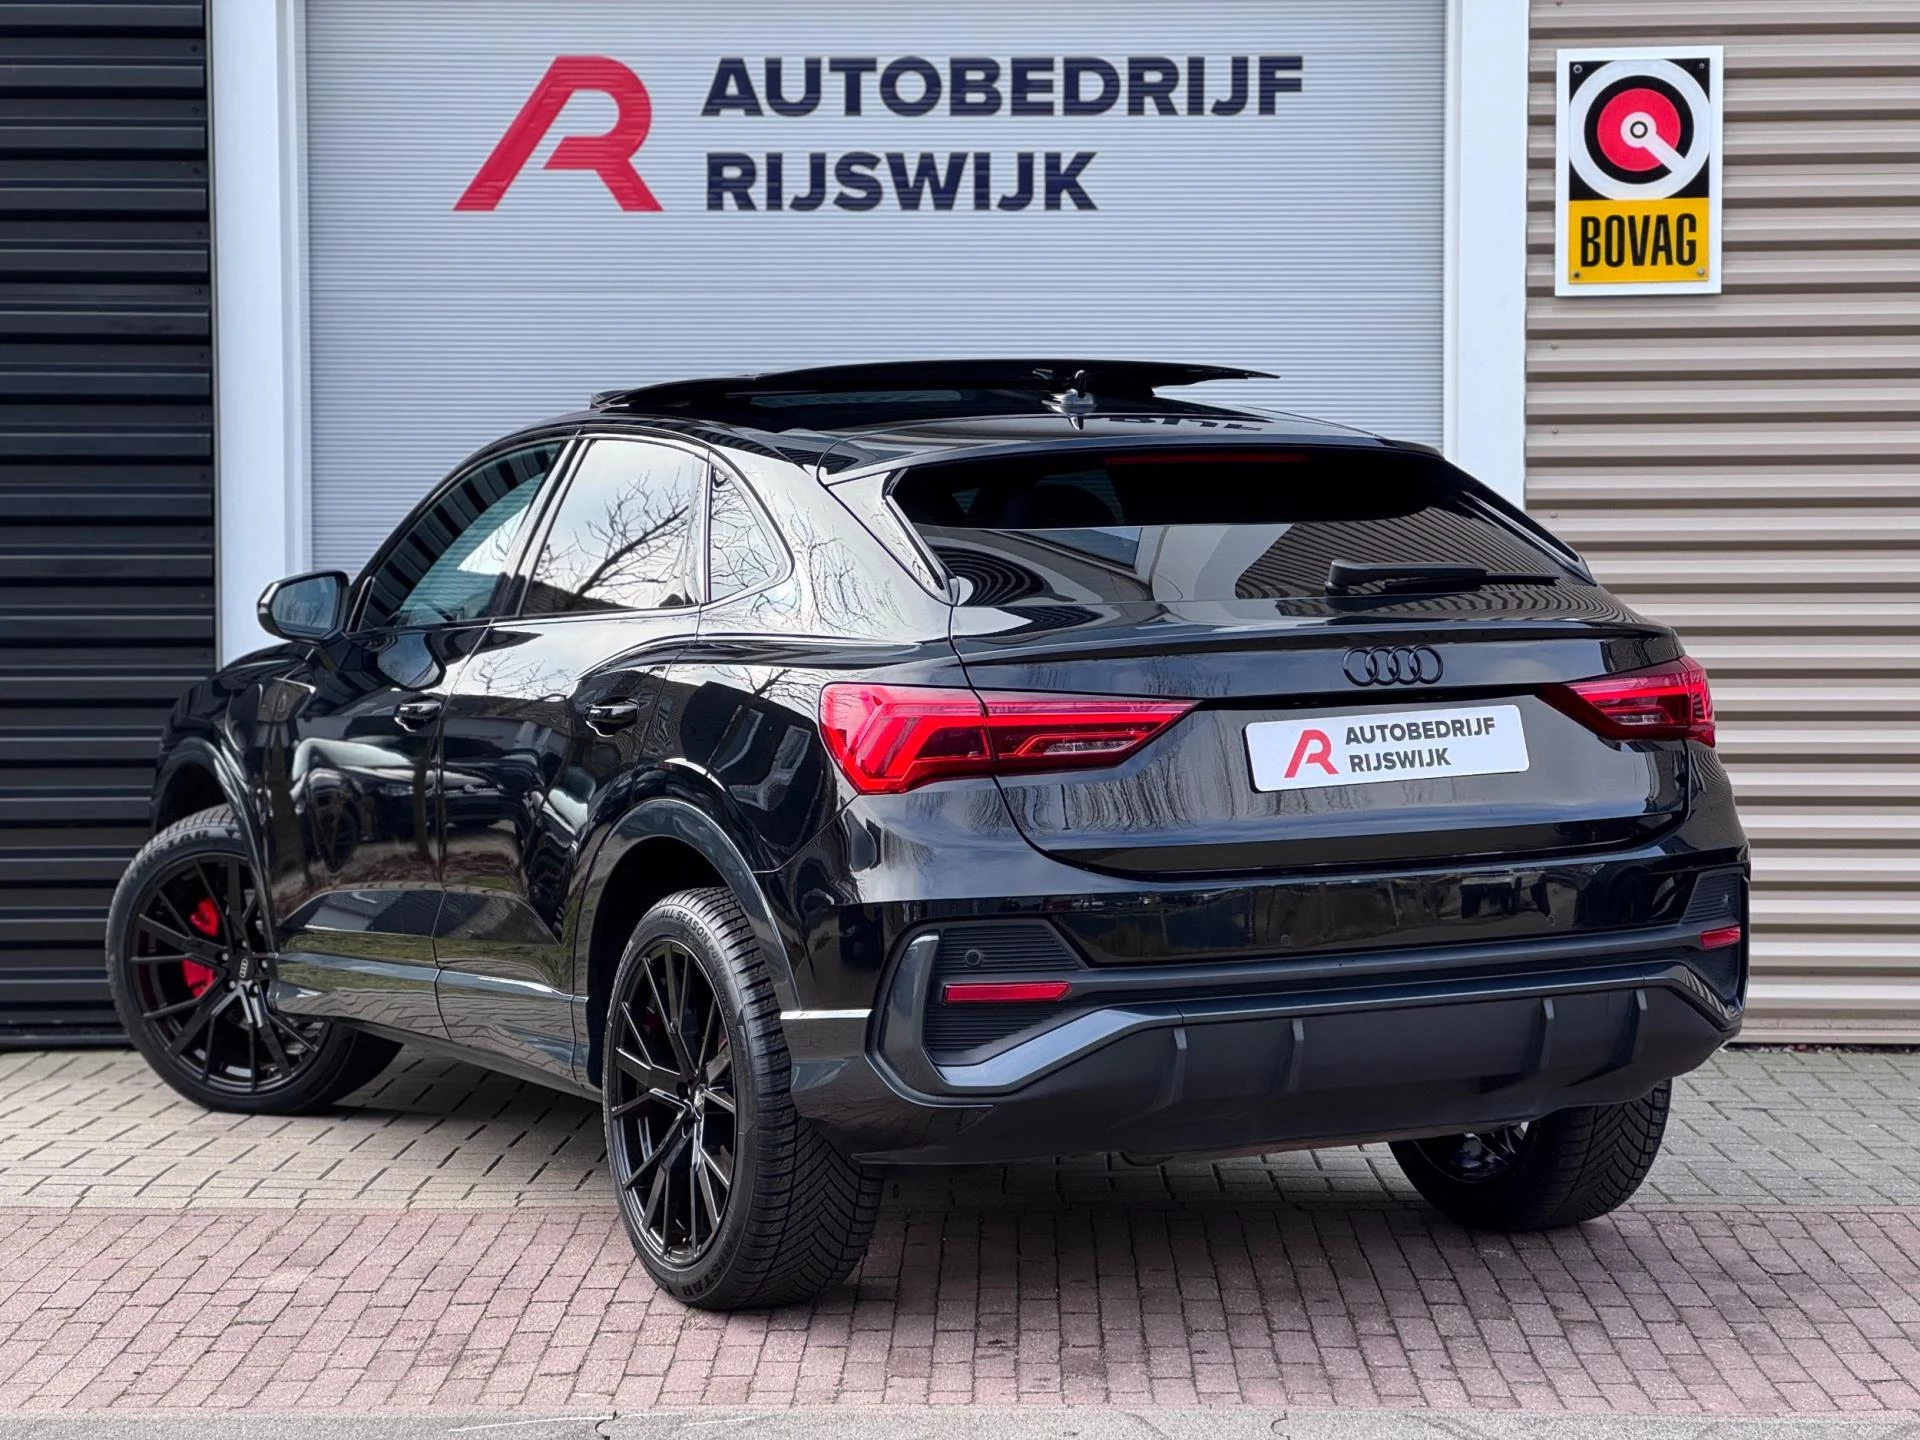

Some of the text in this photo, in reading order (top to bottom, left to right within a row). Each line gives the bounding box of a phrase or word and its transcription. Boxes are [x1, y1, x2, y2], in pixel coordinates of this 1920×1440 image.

[701, 55, 1303, 118] AUTOBEDRIJF
[706, 151, 1098, 212] RIJSWIJK
[1580, 213, 1697, 268] BOVAG
[1345, 717, 1495, 746] AUTOBEDRIJF
[1349, 747, 1452, 774] RIJSWIJK
[659, 908, 675, 919] ALL
[675, 910, 712, 943] SEASON
